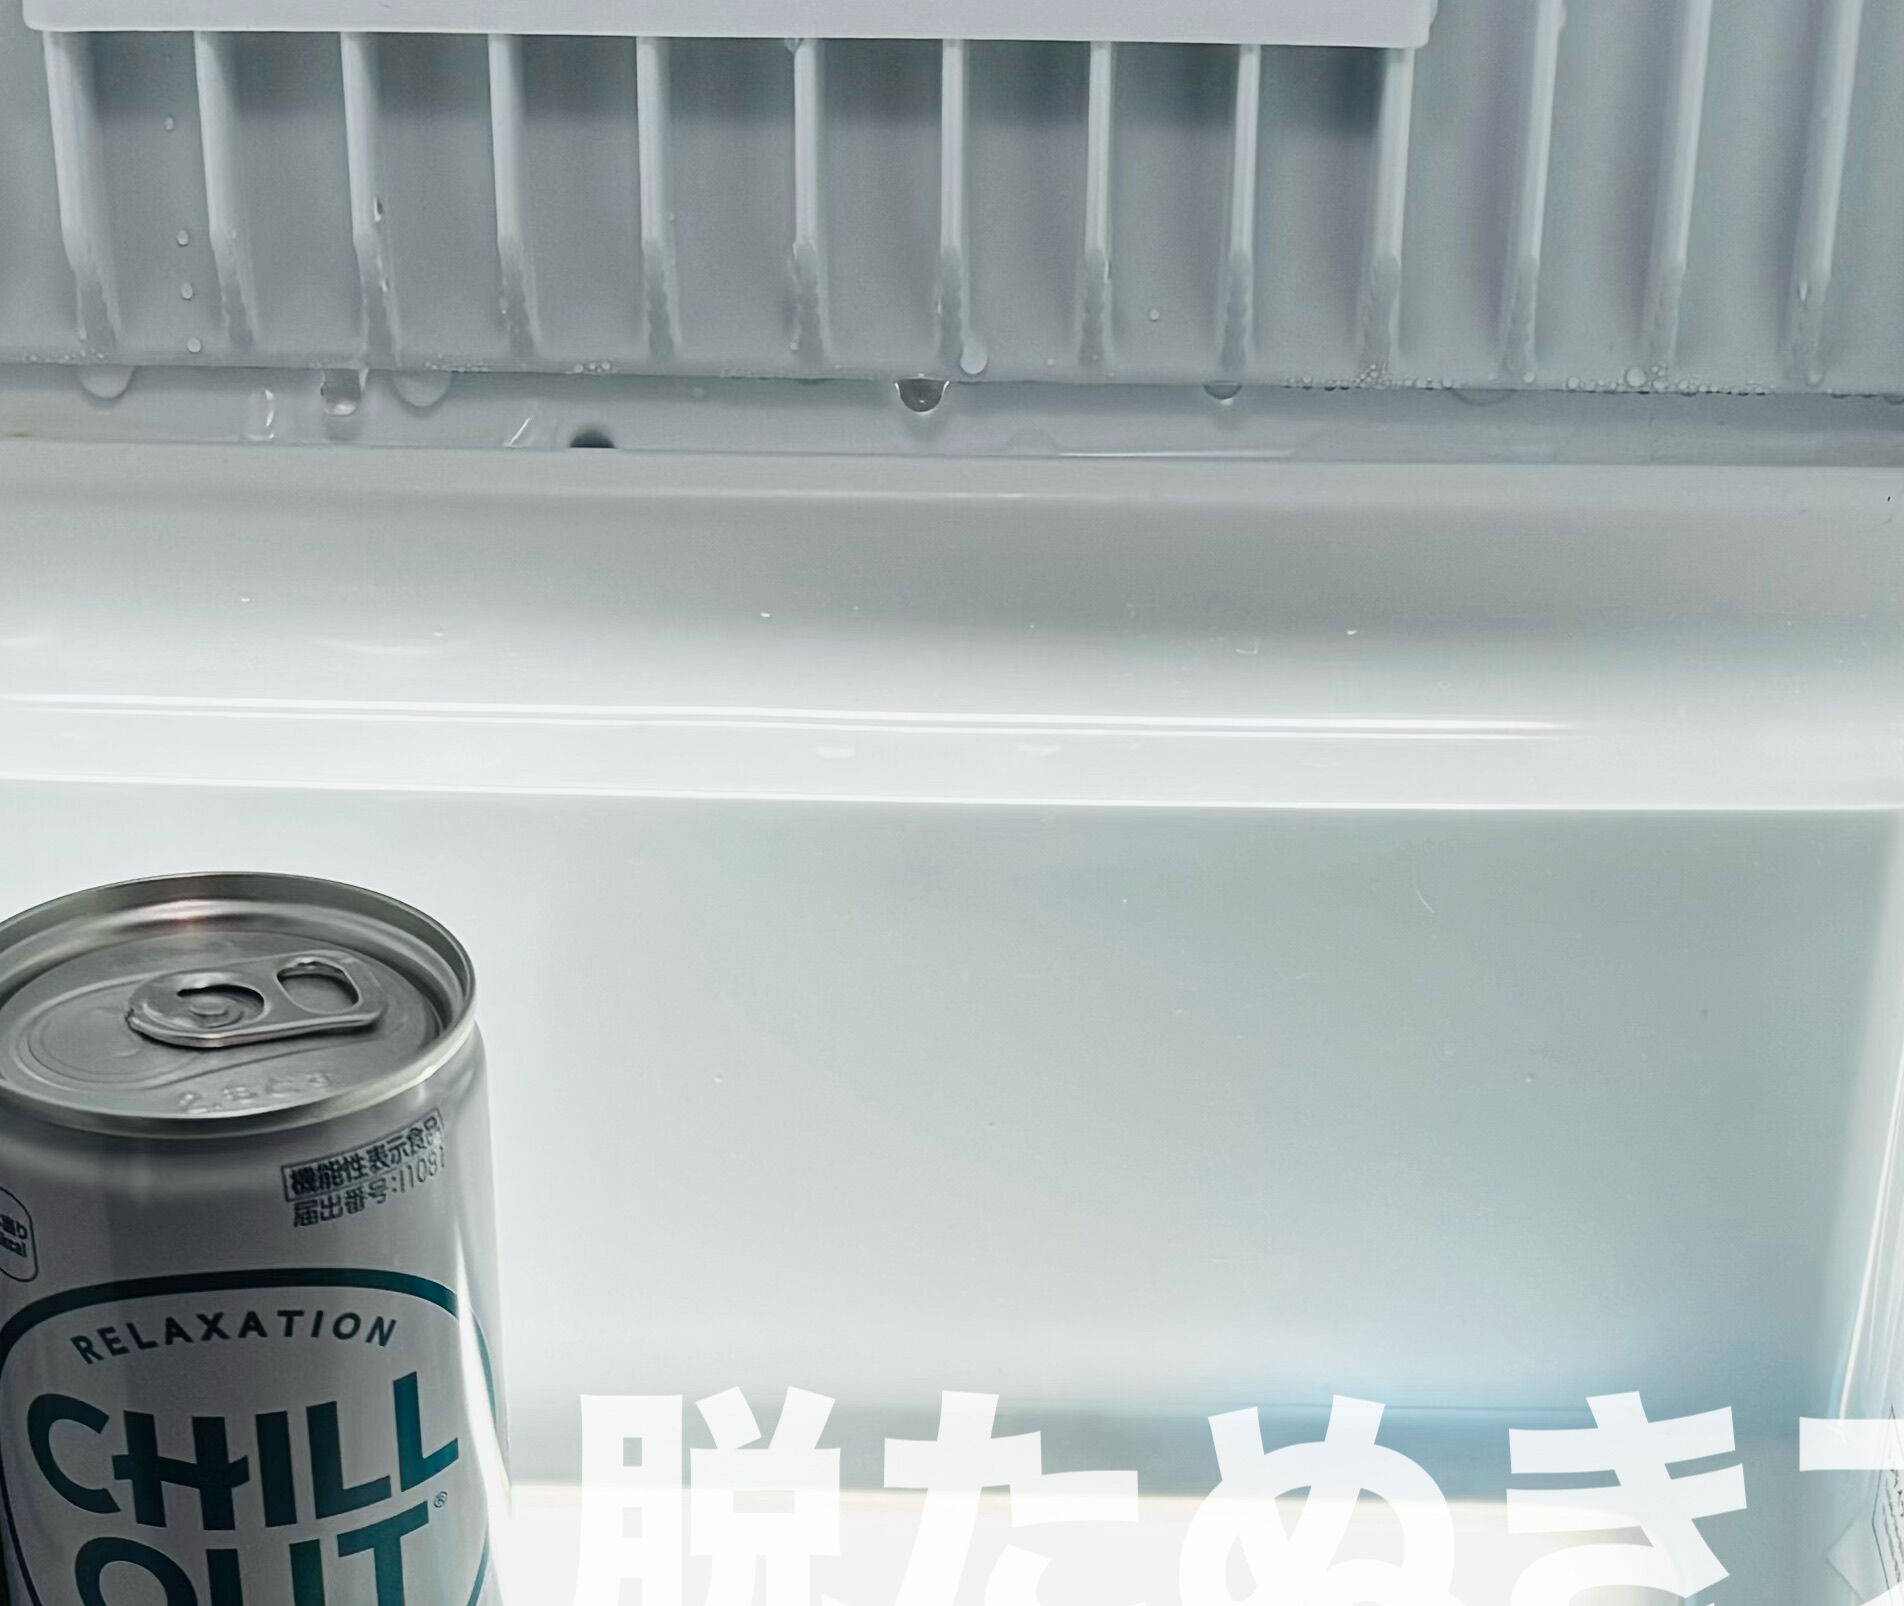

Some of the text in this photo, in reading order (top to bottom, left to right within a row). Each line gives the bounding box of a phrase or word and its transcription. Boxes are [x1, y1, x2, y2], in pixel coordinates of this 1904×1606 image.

[289, 1116, 443, 1197] 機能性表示食品
[70, 1309, 397, 1365] RELAXATION
[26, 1370, 460, 1531] CHILL
